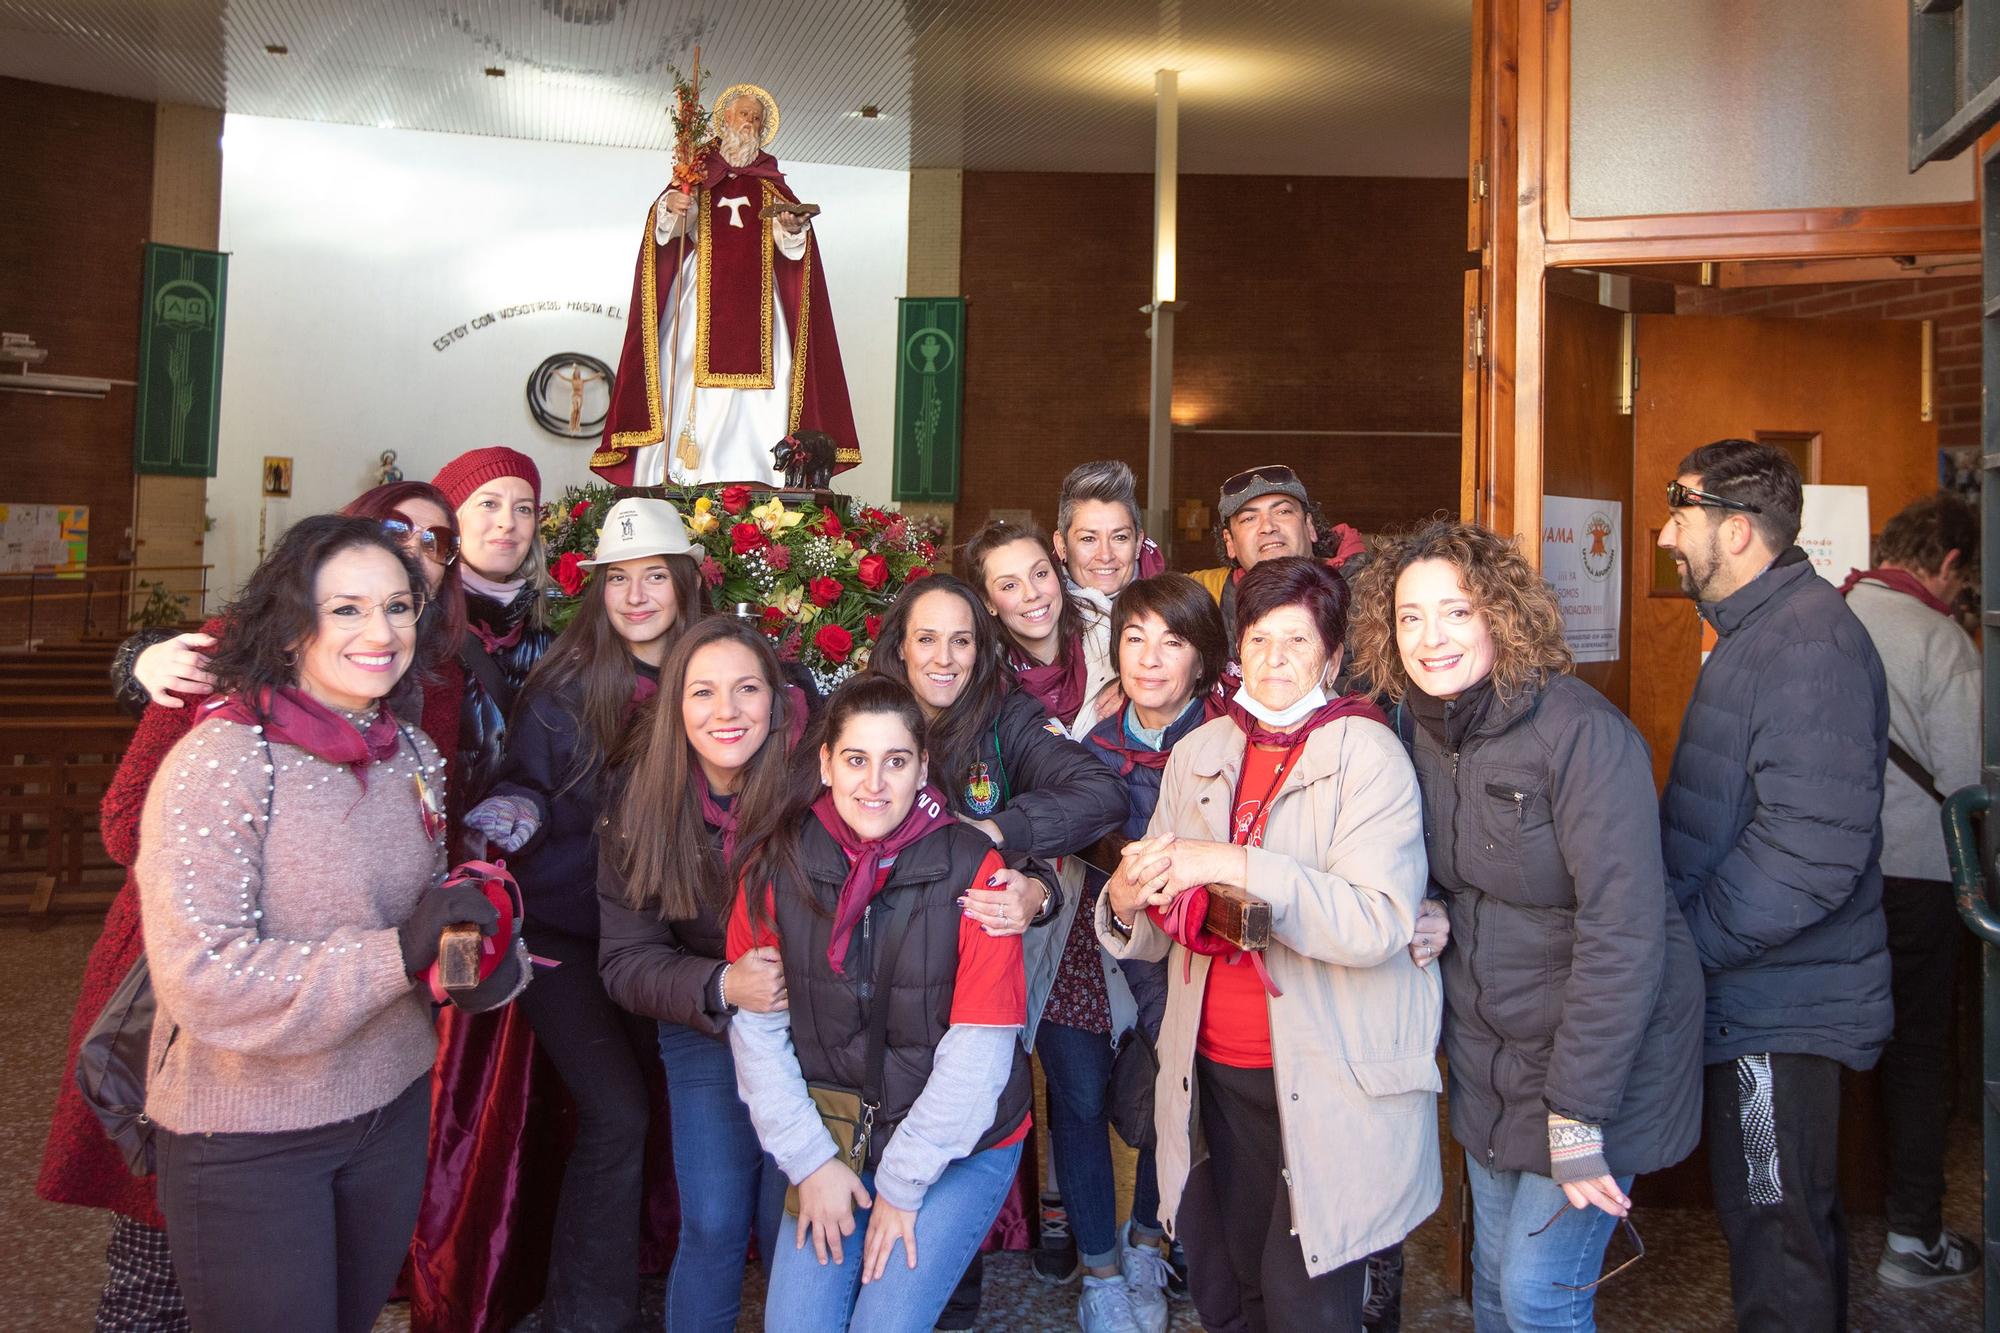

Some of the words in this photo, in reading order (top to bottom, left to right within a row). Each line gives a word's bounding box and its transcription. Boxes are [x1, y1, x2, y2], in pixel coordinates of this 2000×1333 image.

[433, 324, 470, 352] ESTOY
[471, 313, 496, 331] CON
[566, 301, 603, 314] HASTA
[607, 306, 622, 320] EL
[1557, 588, 1580, 599] SOMOS
[1559, 604, 1592, 616] UNDACION
